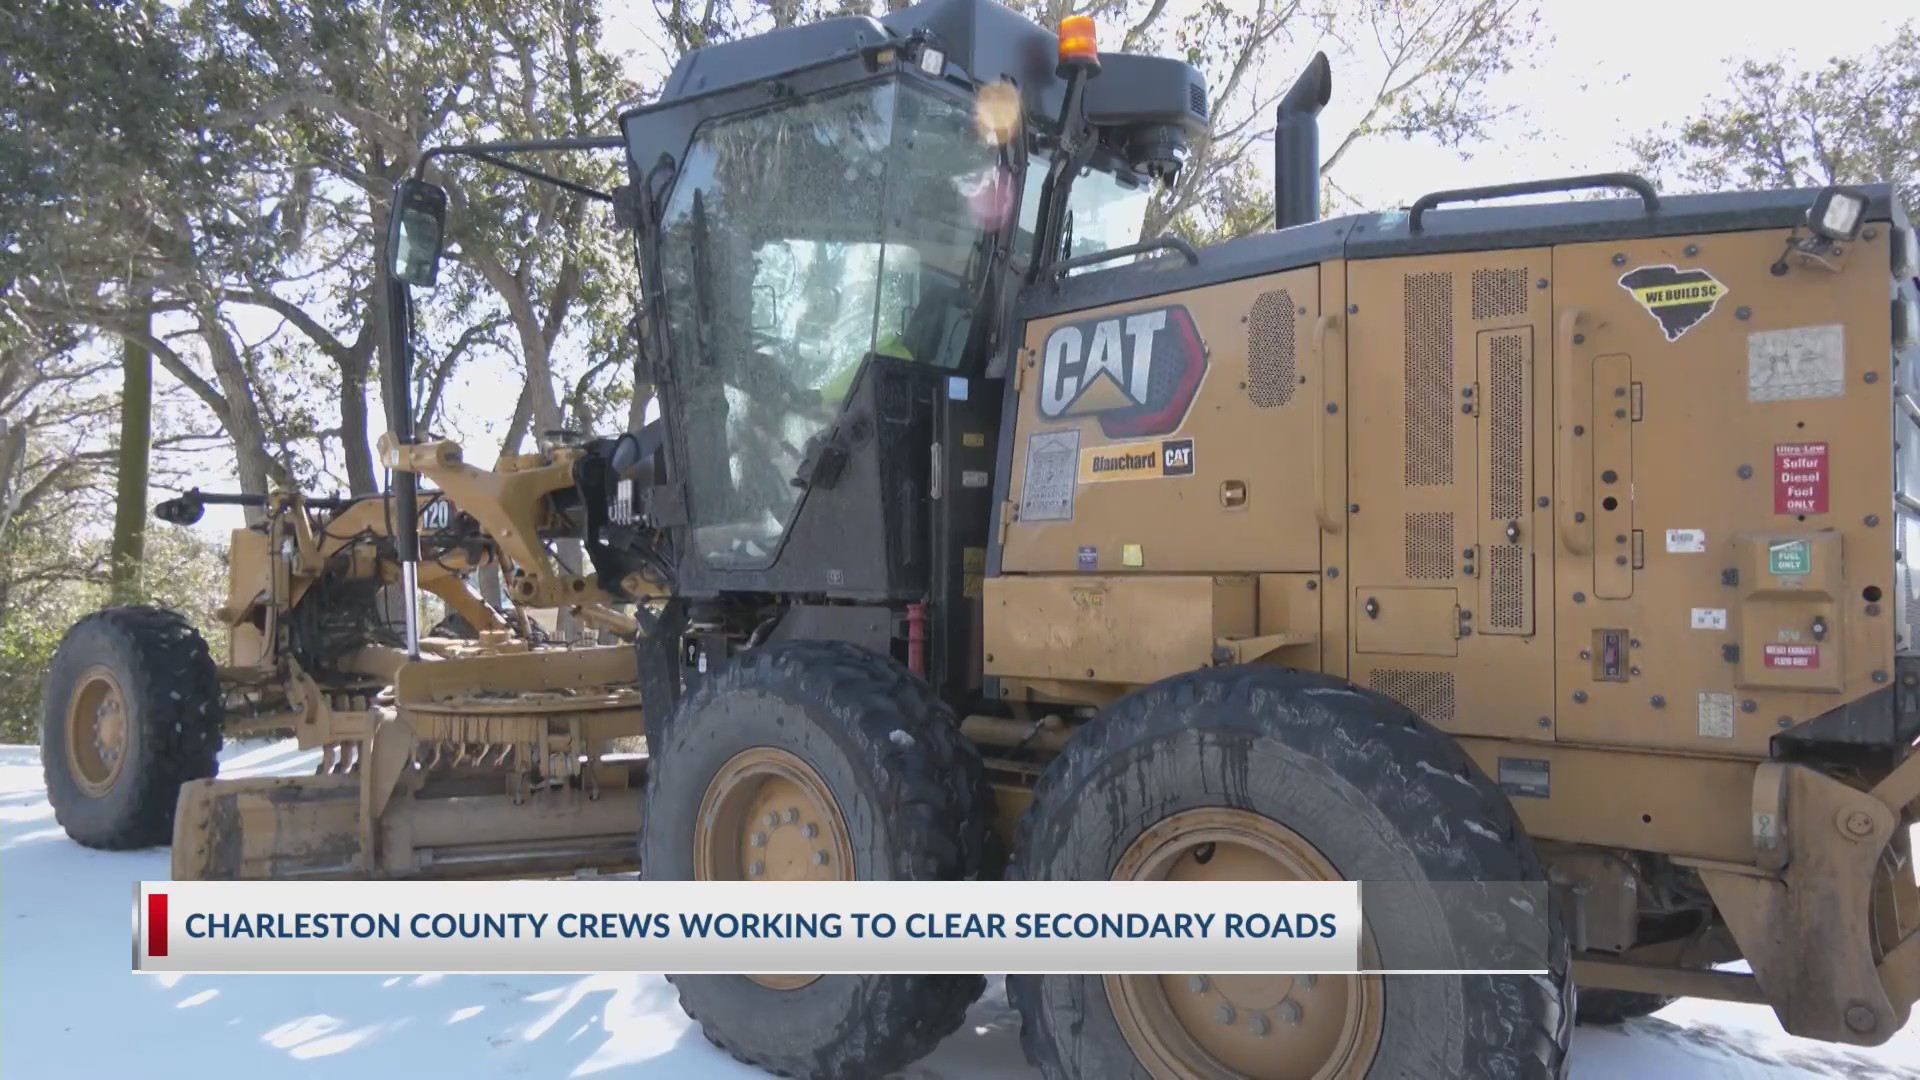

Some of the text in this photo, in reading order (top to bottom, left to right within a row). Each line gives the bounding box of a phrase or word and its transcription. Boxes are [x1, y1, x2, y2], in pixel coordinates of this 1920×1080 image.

[1646, 284, 1717, 303] WE BUILD SC
[1040, 310, 1167, 417] CAT
[1092, 447, 1191, 473] Blanchard CAT
[1783, 458, 1819, 469] Sulfur
[1781, 471, 1820, 484] Diesel
[1787, 486, 1813, 497] Fuel
[1787, 499, 1815, 509] ONLY
[1778, 552, 1801, 560] FUEL
[1778, 561, 1801, 569] ONLY
